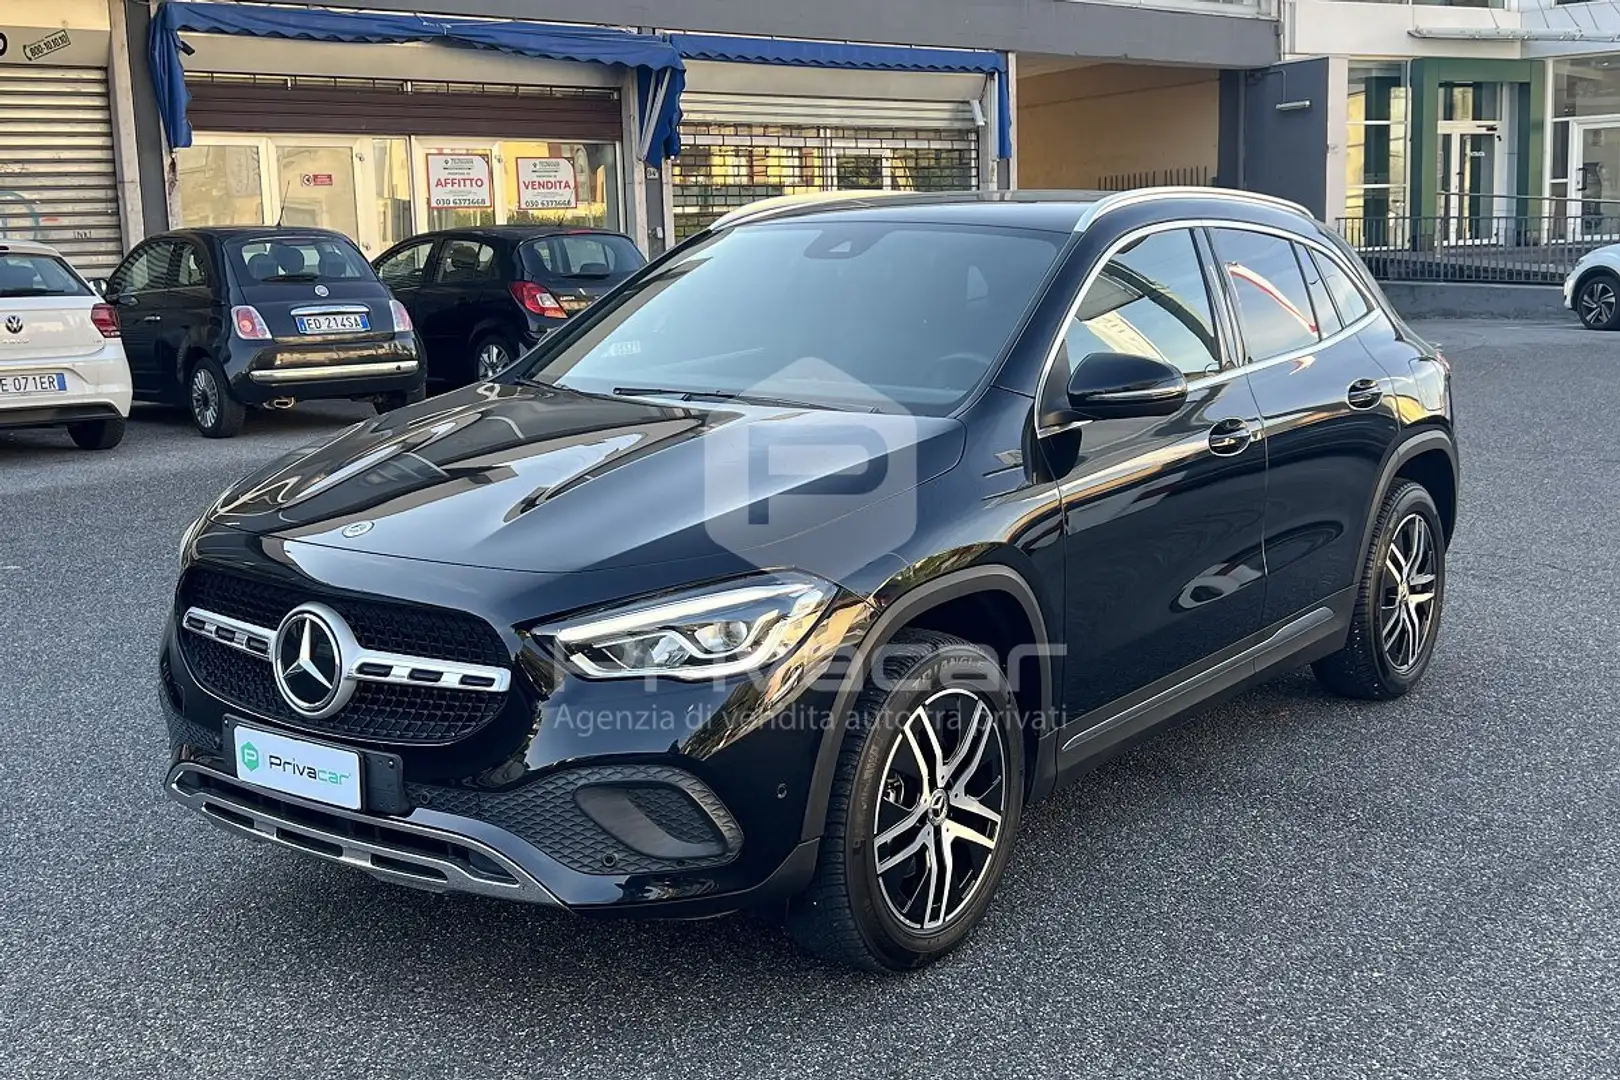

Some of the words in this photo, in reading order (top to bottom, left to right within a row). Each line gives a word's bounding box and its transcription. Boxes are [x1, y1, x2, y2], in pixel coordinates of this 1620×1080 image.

[435, 178, 484, 187] AFFITTO
[523, 180, 571, 190] VENDITA
[13, 375, 56, 391] 071ER
[268, 754, 351, 785] Privacar
